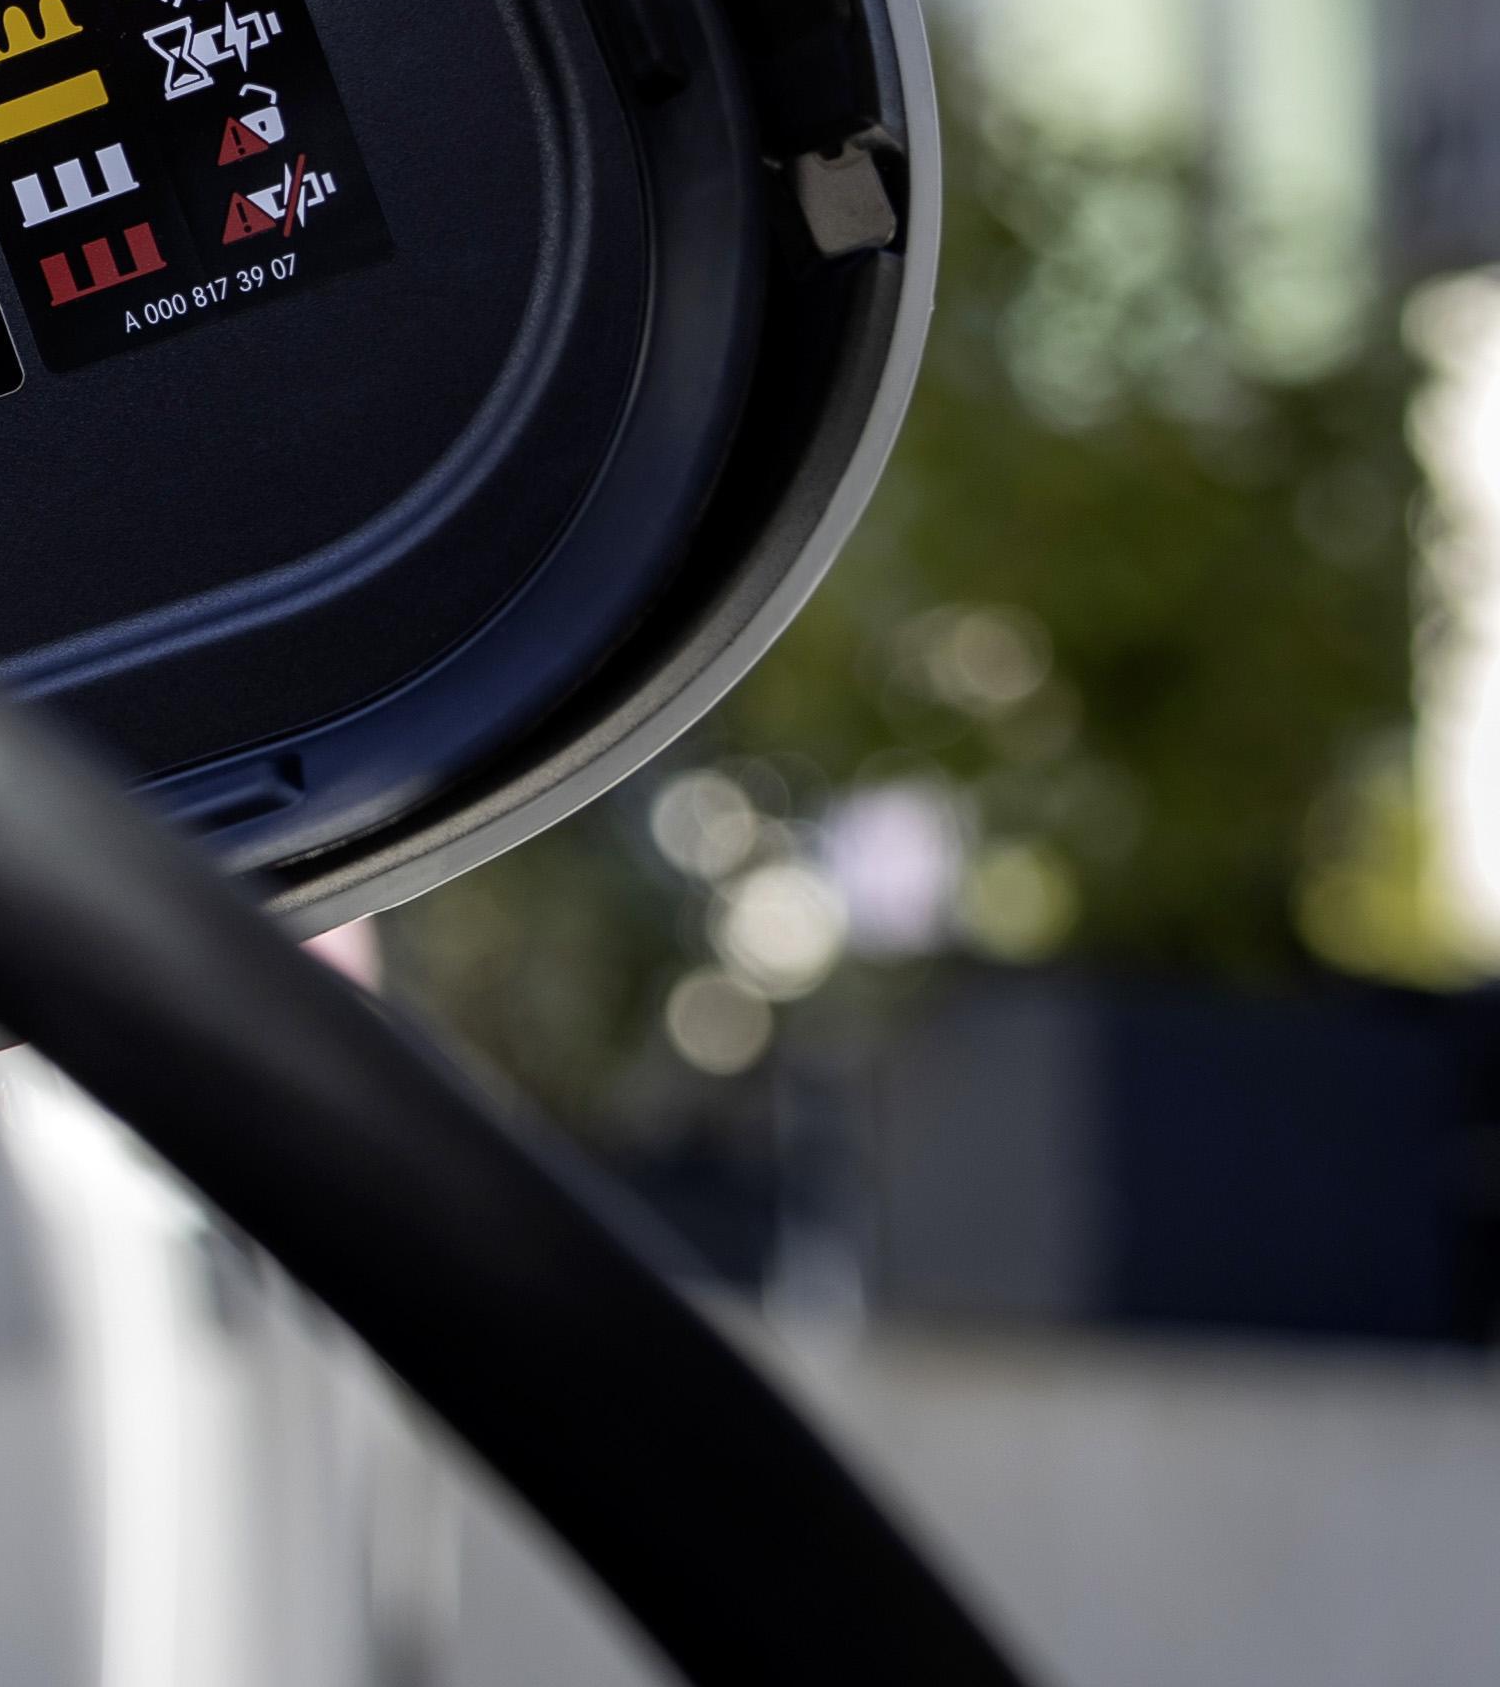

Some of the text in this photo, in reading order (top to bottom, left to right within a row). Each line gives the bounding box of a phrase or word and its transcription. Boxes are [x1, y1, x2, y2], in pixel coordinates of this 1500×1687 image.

[124, 252, 296, 333] A 000 817 39 07
